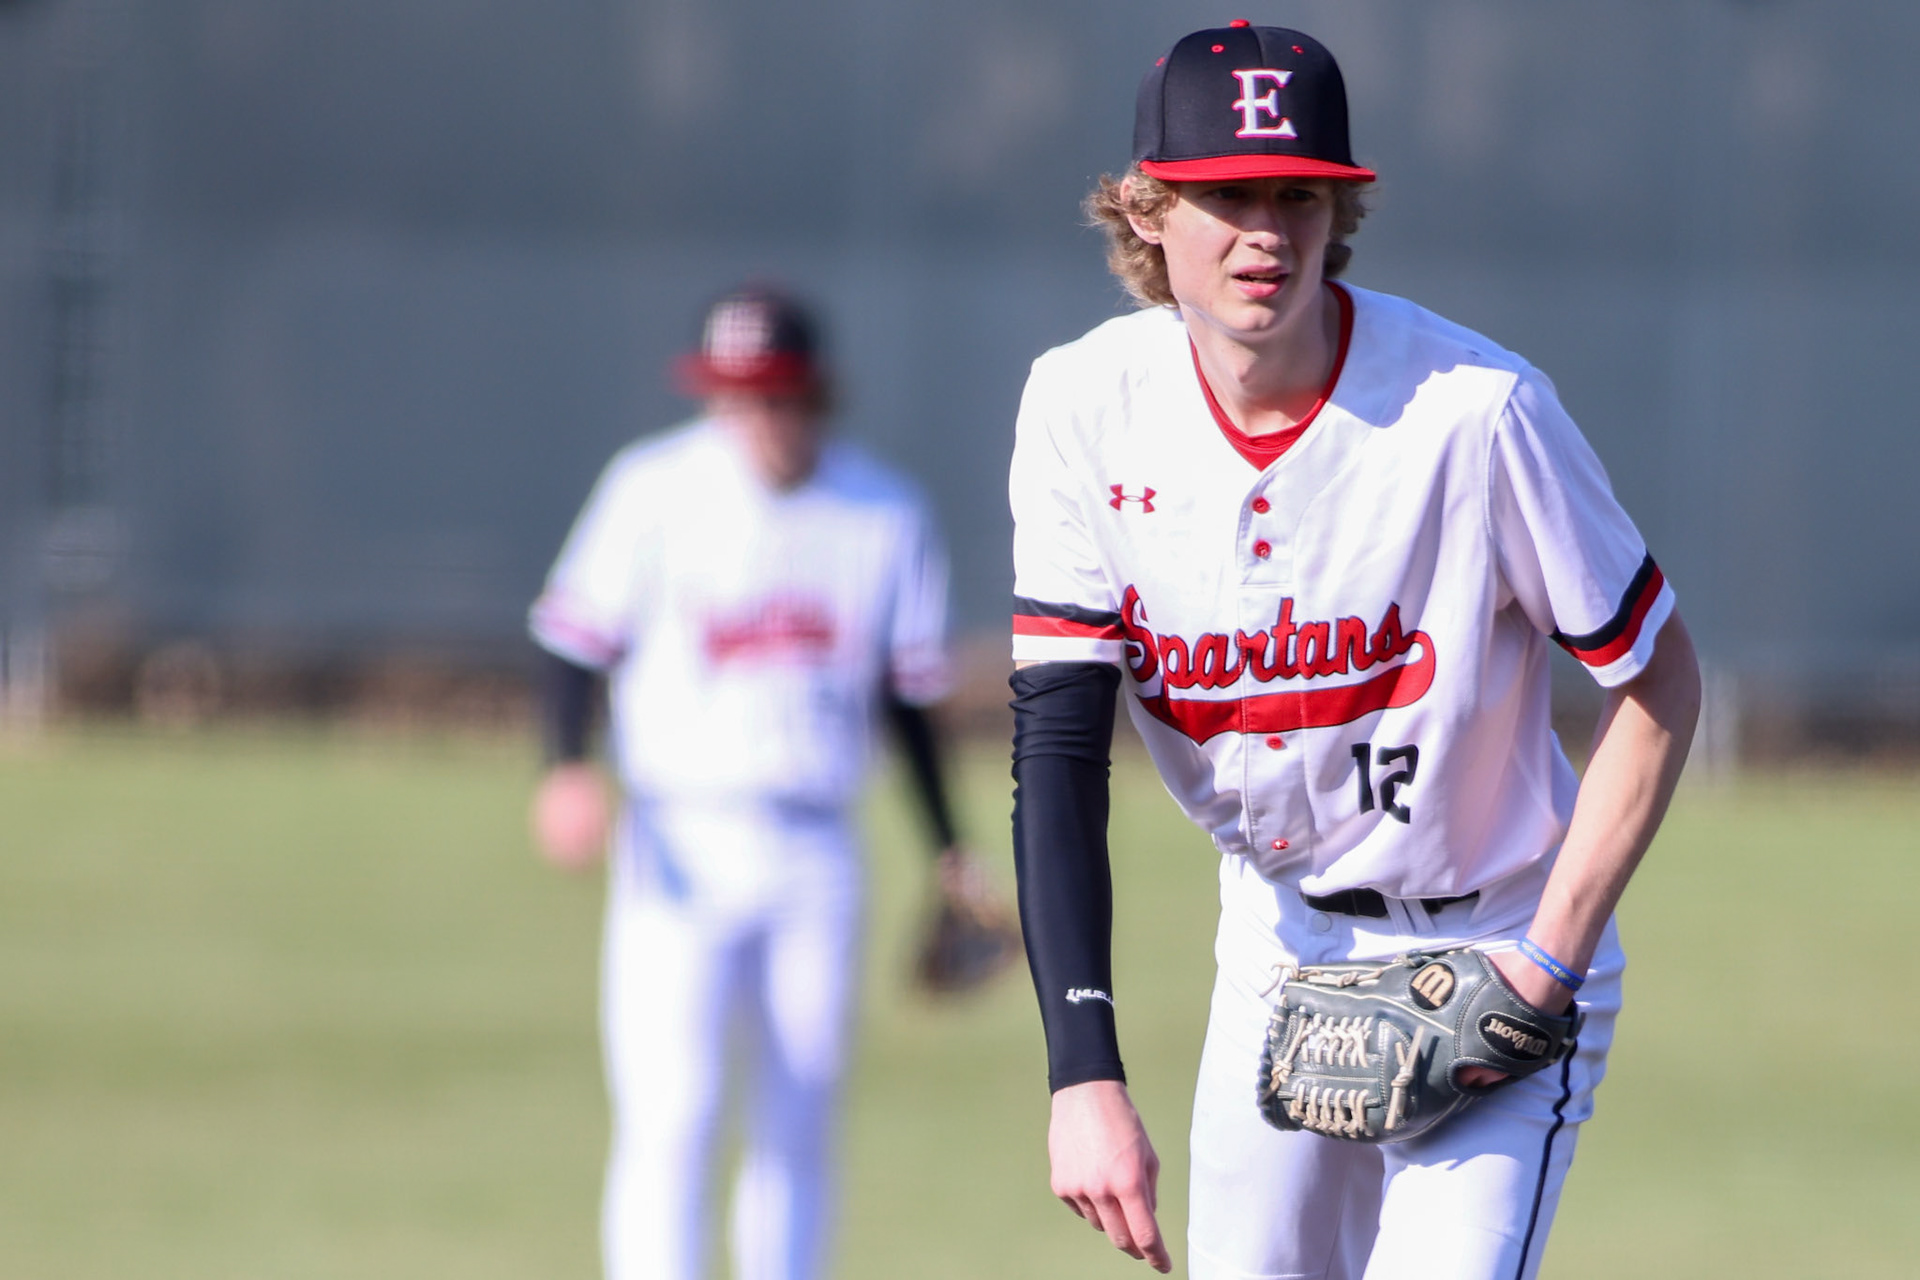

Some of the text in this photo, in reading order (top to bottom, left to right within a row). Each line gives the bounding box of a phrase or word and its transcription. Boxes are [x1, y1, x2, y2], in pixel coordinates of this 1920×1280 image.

[1231, 68, 1298, 139] E
[1119, 583, 1410, 712] Spartans
[1351, 742, 1419, 824] 12
[1487, 1018, 1548, 1056] Wilson
